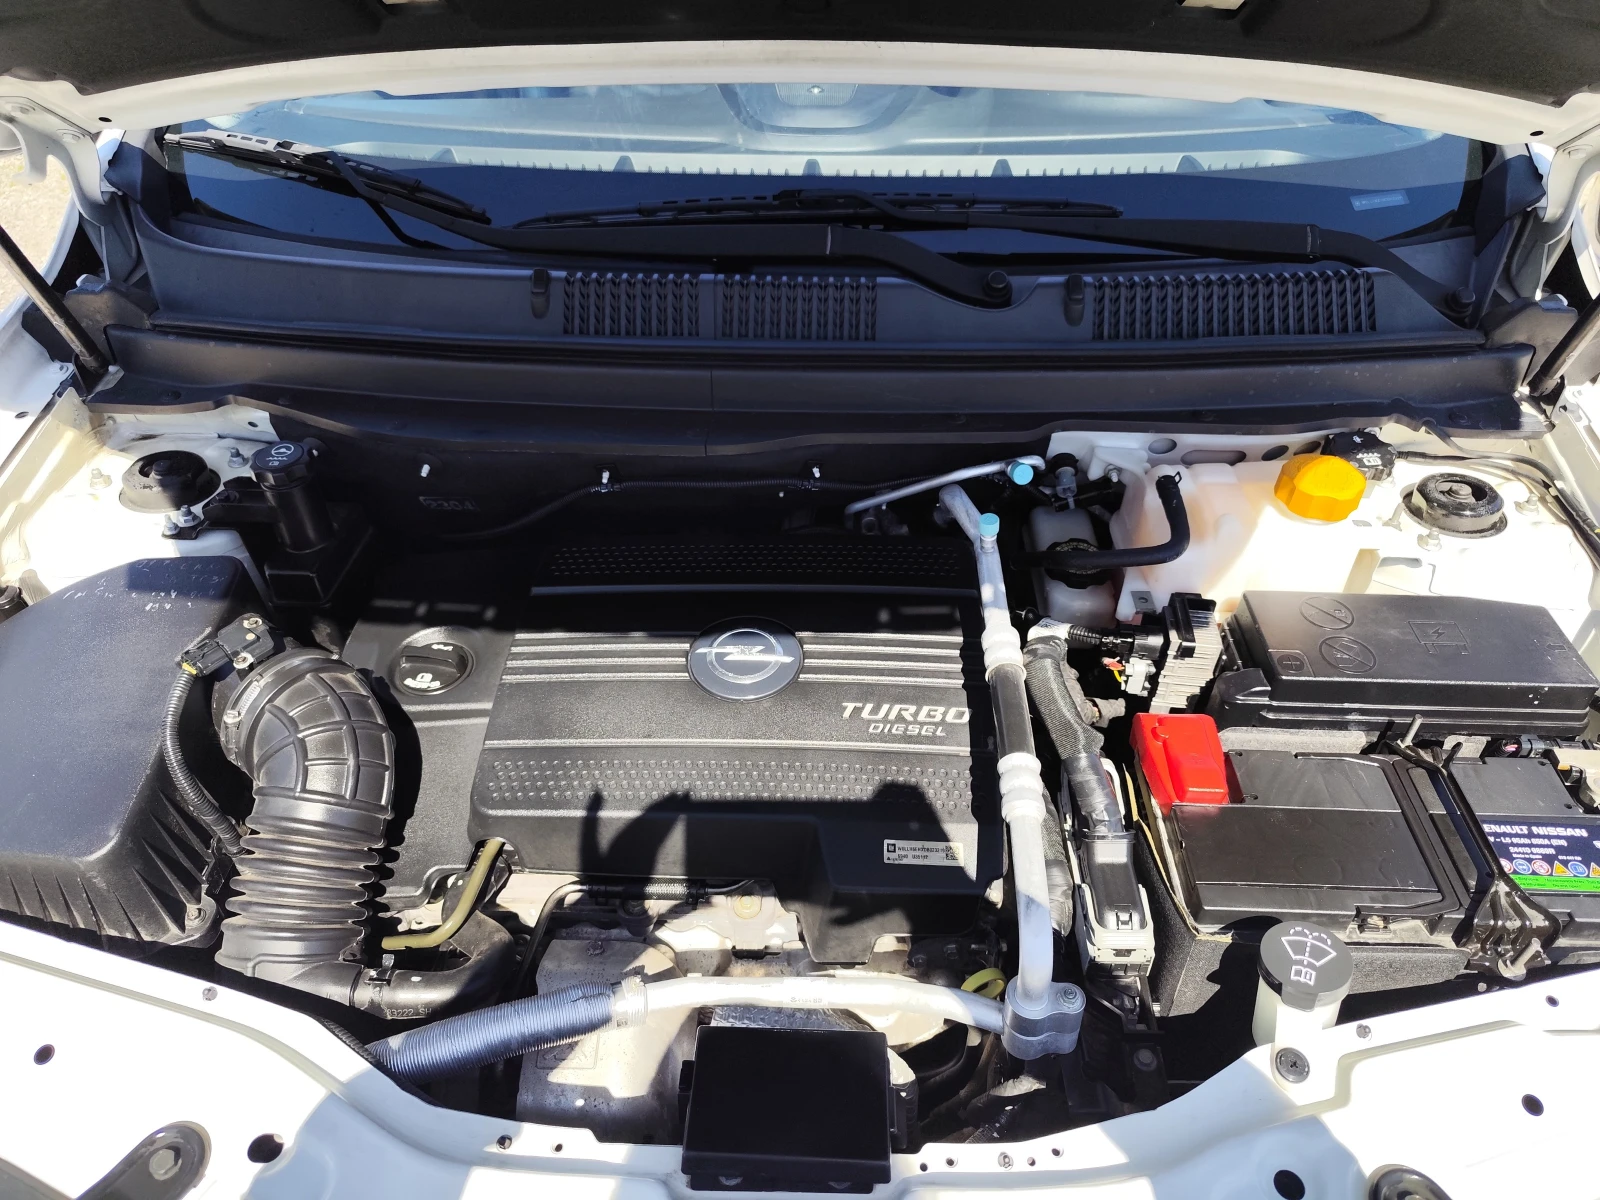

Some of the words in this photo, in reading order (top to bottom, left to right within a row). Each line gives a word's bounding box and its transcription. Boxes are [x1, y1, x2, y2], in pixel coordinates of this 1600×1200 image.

[841, 702, 973, 723] TURBO
[868, 723, 947, 736] DIESEL
[1483, 824, 1529, 834] ENAULT
[1531, 826, 1589, 837] NISSAN
